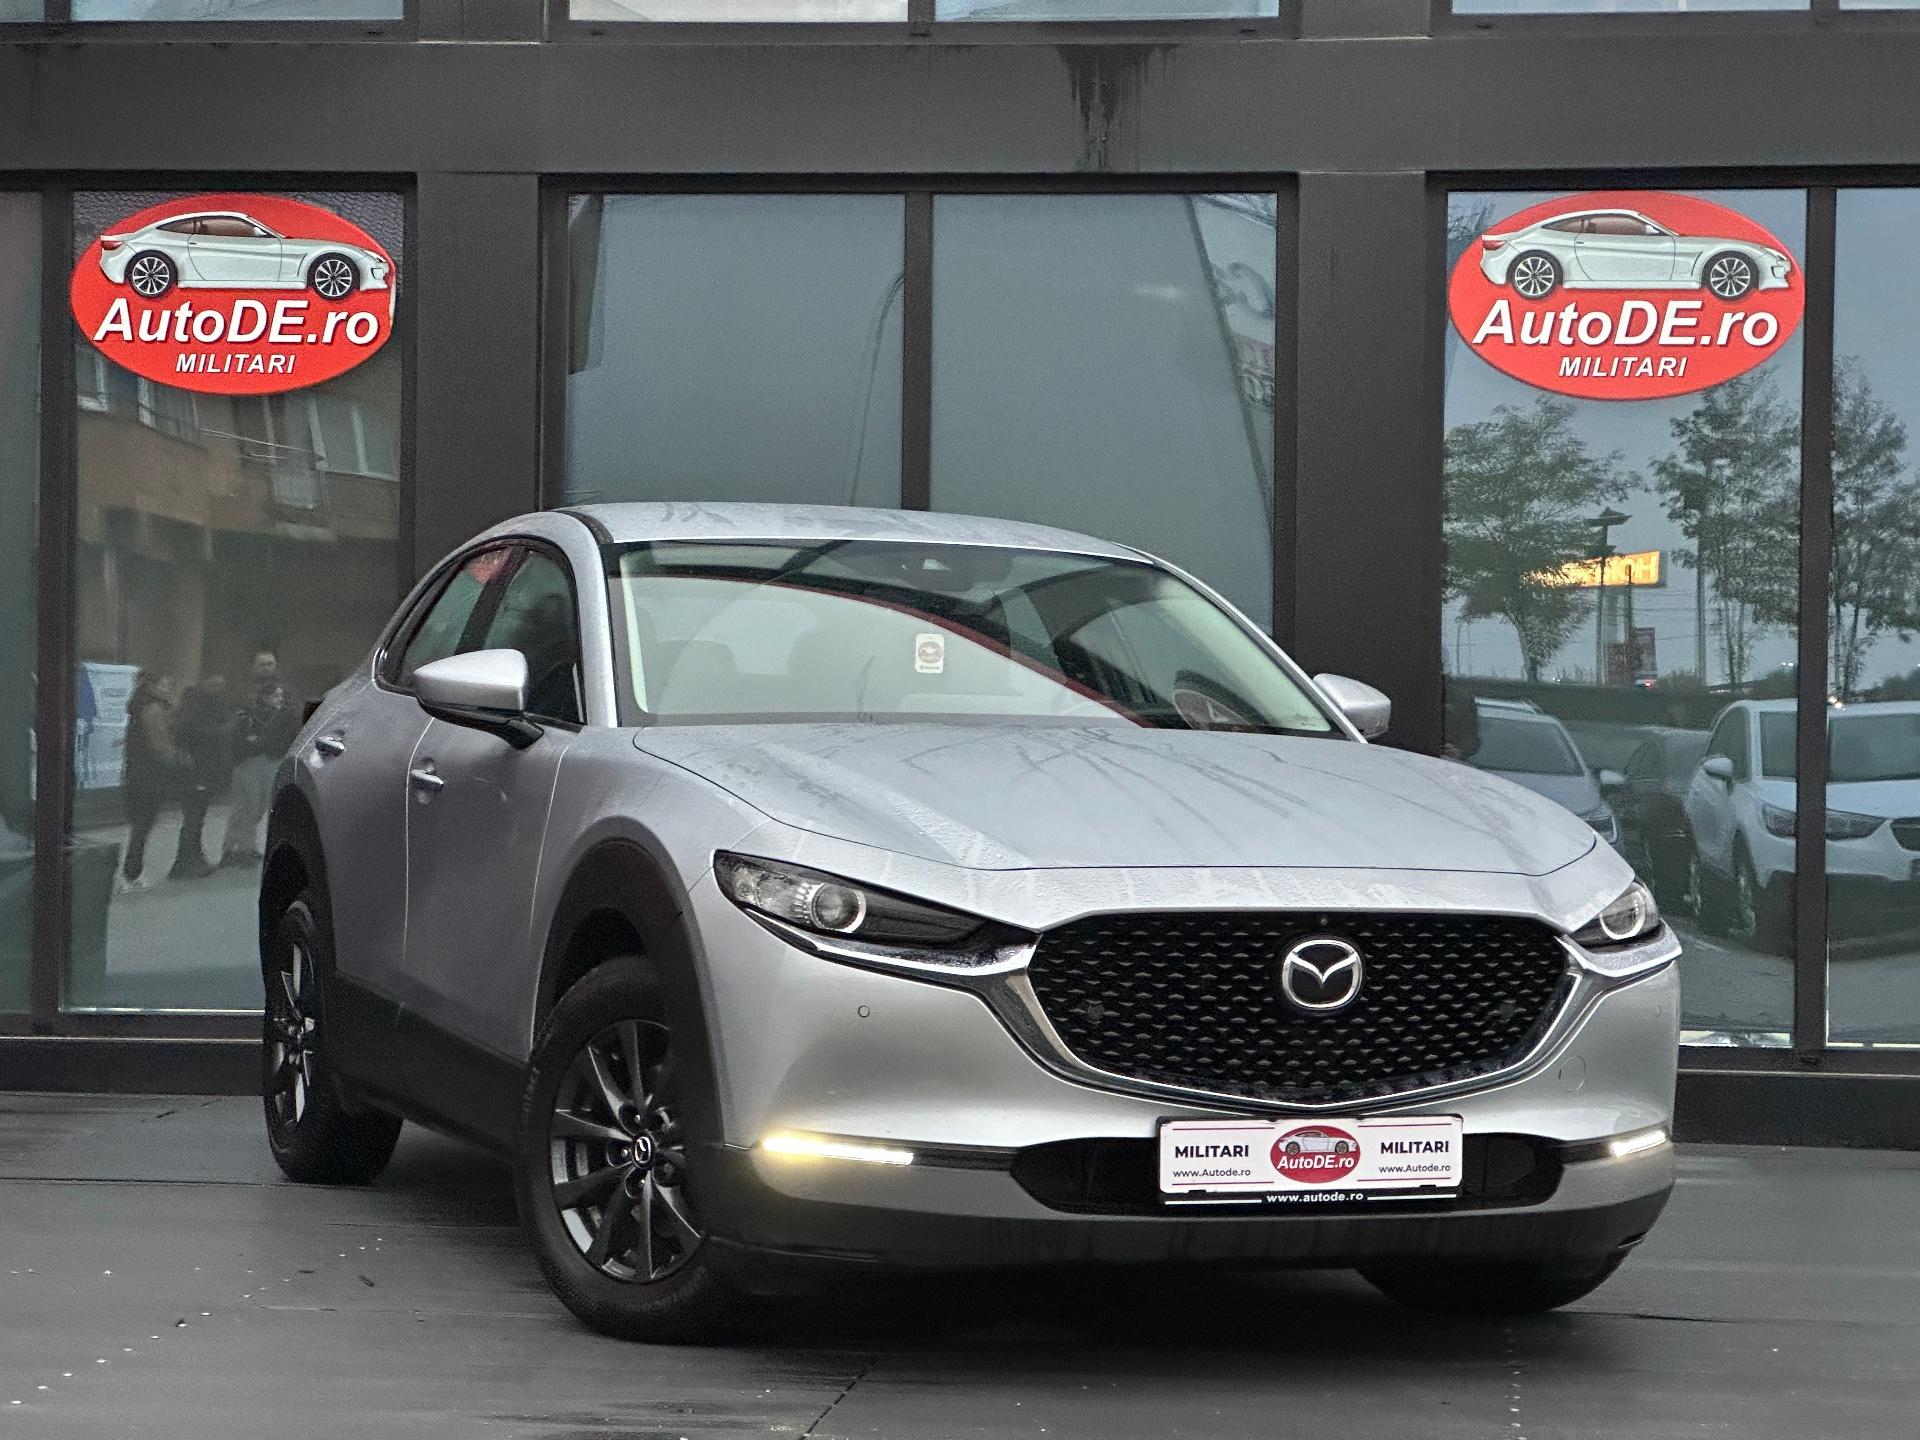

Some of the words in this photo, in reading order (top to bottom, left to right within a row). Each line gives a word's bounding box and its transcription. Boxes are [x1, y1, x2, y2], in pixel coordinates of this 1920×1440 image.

[94, 298, 380, 345] AutoDE.ro
[1472, 299, 1779, 347] AutoDE.ro
[175, 354, 297, 375] MILITARI
[1558, 356, 1688, 378] MILITARI
[1174, 1144, 1250, 1159] MILITARI
[1380, 1140, 1450, 1155] MILITARI
[1276, 1154, 1355, 1170] AutoDE.ro
[1378, 1163, 1451, 1174] www.Autode.ro
[1172, 1167, 1251, 1178] www.Autode.ro
[1266, 1191, 1364, 1203] www.autode.ro
